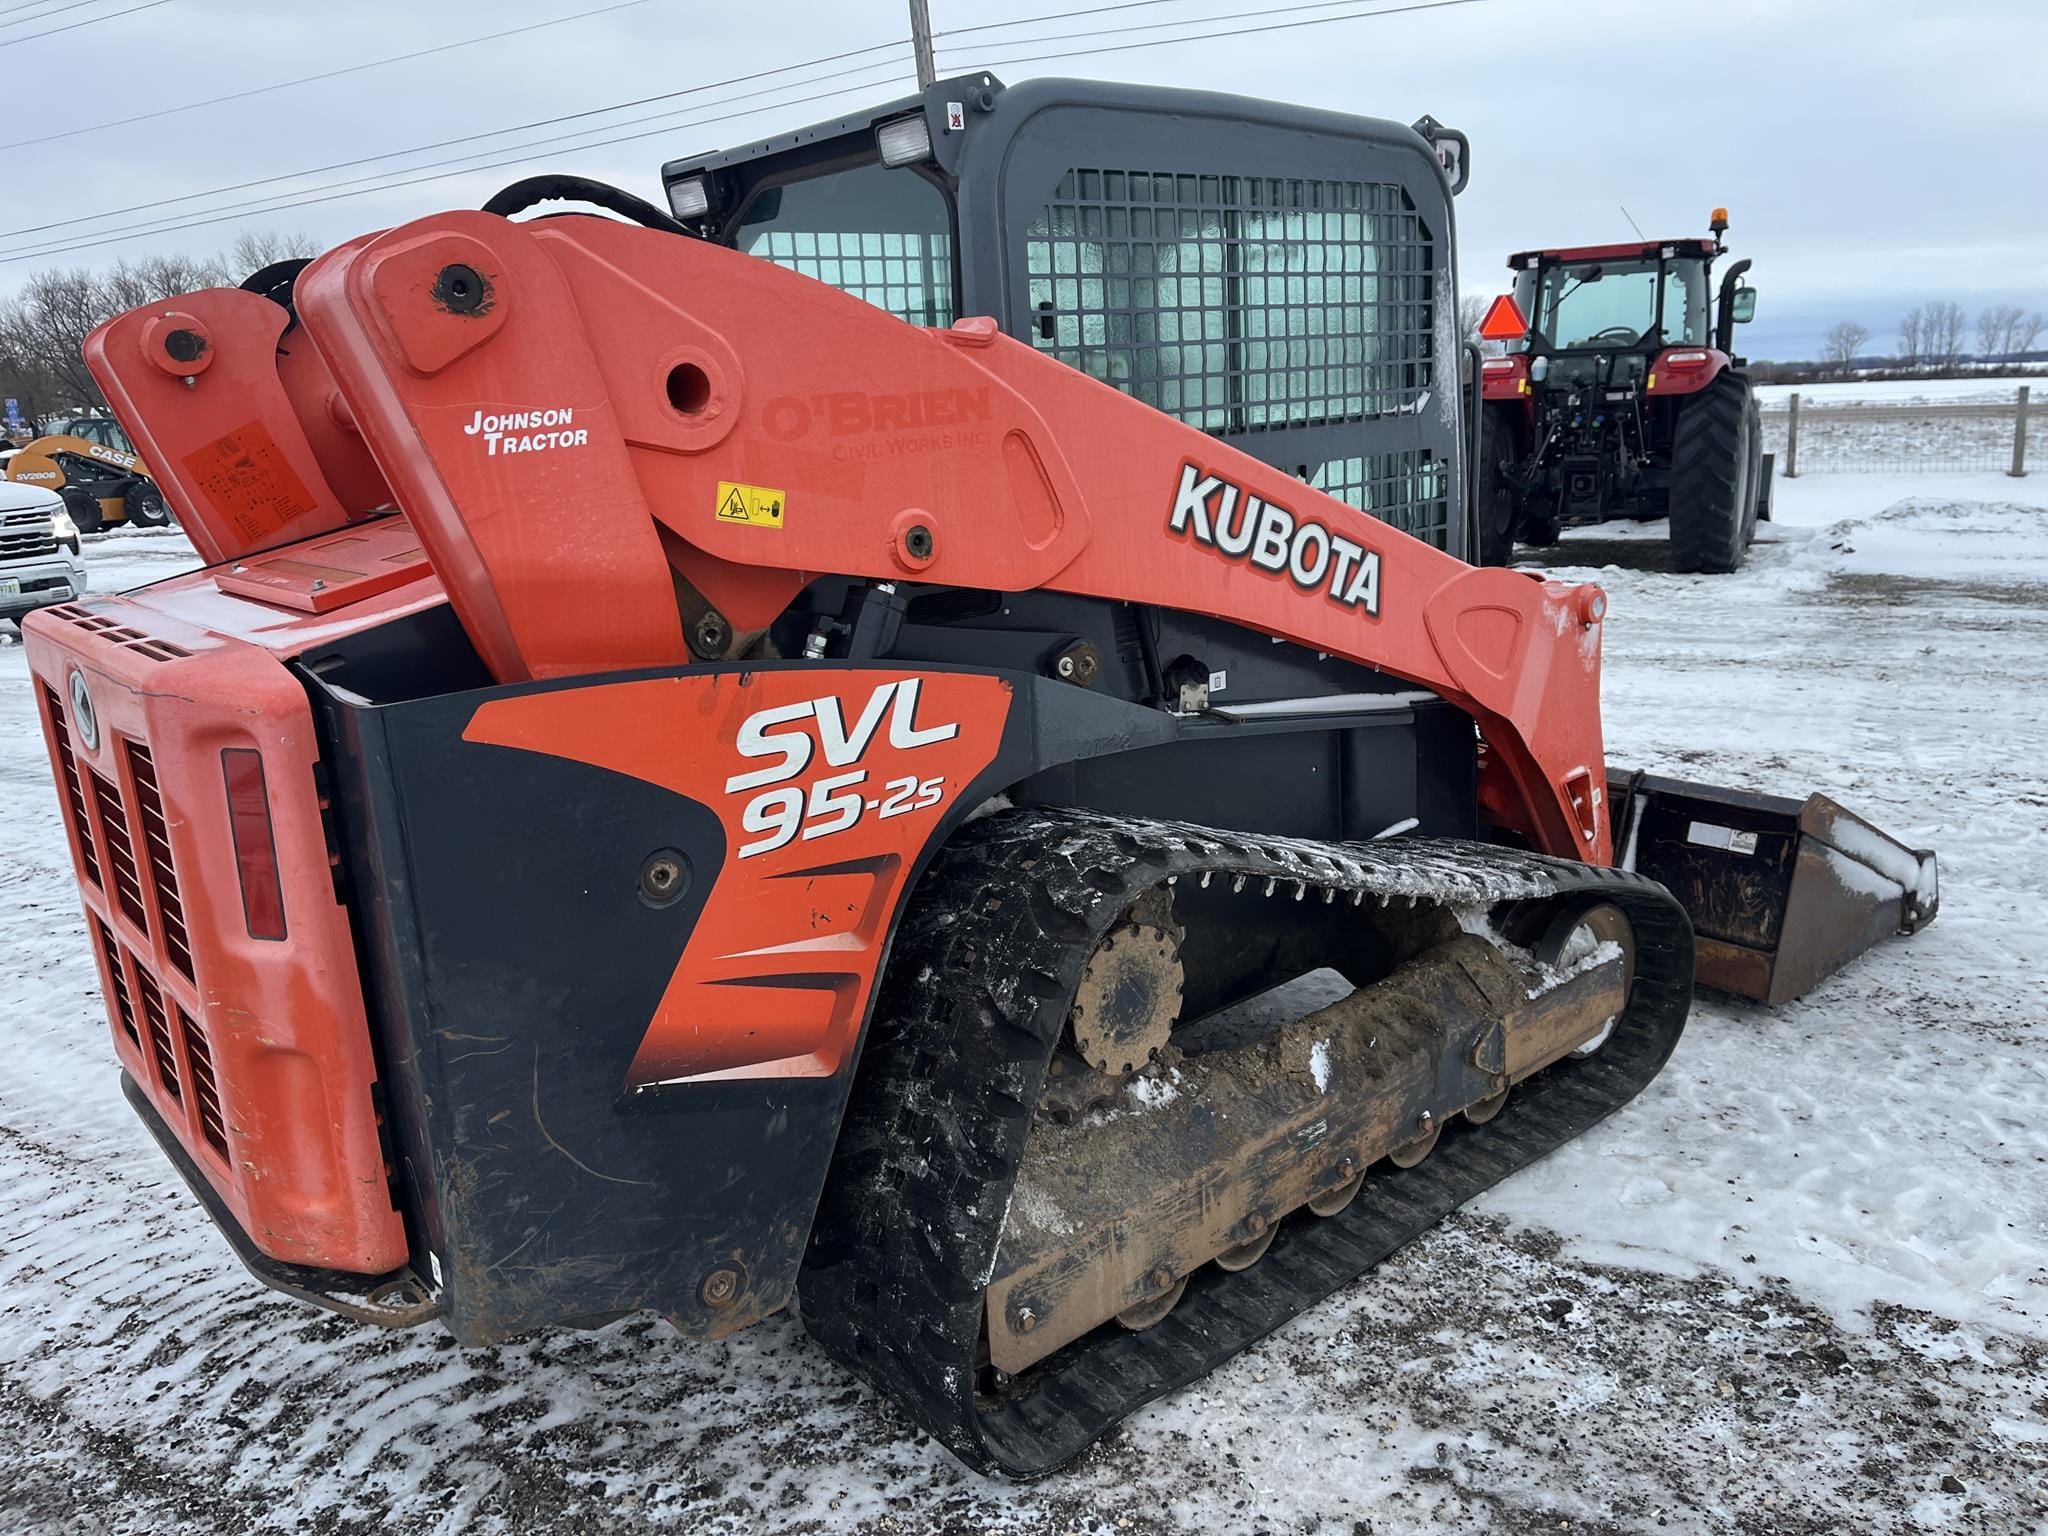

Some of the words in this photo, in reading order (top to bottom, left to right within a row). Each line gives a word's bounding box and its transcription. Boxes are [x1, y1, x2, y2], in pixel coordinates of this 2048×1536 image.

[463, 407, 573, 435] JOHNSON
[762, 385, 993, 442] O'BRIEN
[483, 429, 588, 456] TRACTOR
[832, 443, 882, 462] CIVIL
[886, 435, 953, 456] WORKS
[89, 445, 137, 469] CASE
[1169, 463, 1381, 618] KUBOTA
[725, 677, 960, 794] SVL
